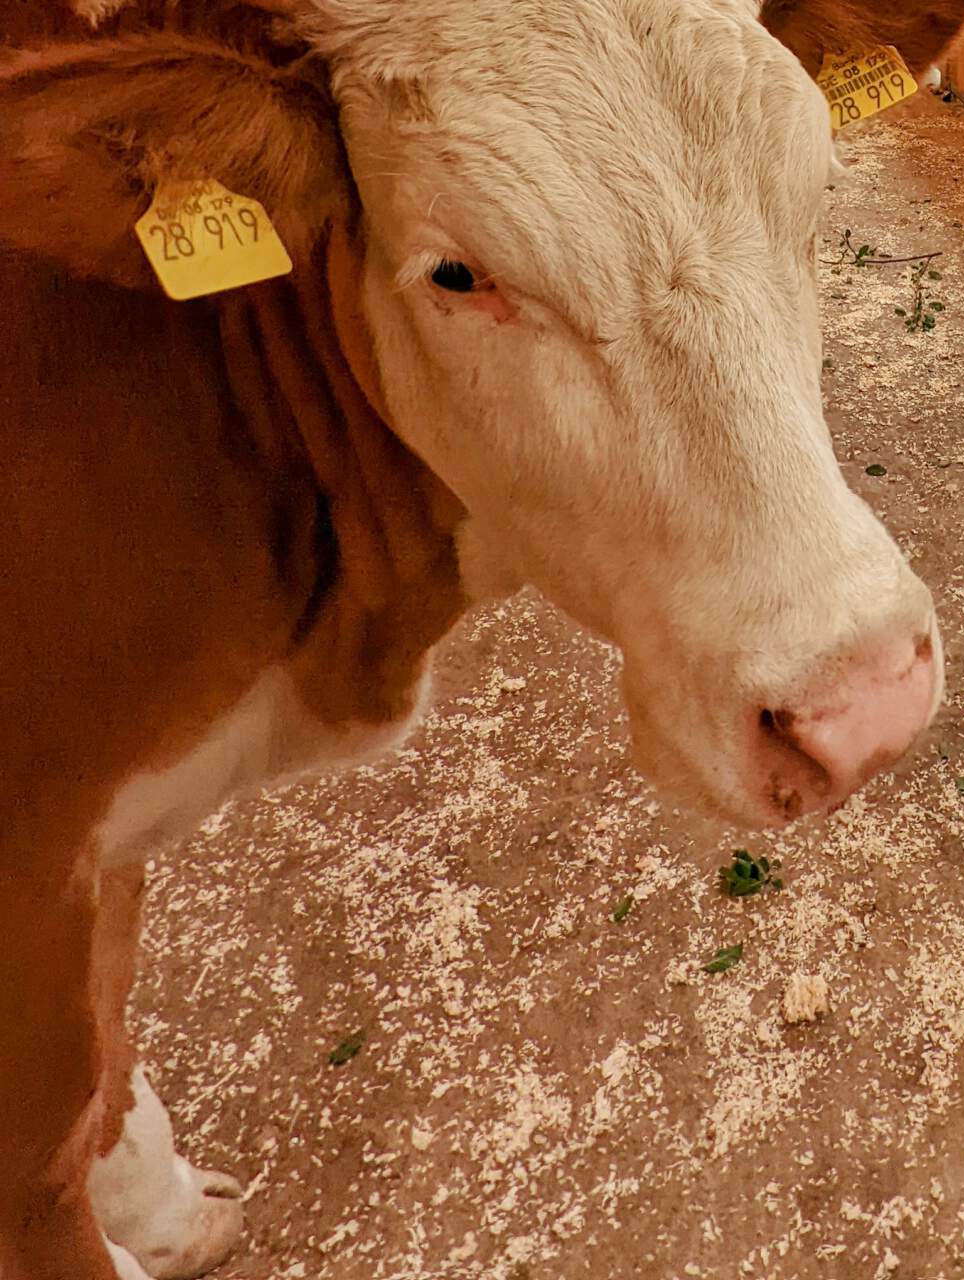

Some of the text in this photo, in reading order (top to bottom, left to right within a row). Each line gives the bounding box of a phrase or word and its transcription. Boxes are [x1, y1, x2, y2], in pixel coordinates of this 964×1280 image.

[843, 65, 860, 79] 08
[831, 73, 904, 127] 28 919
[149, 208, 259, 261] 28 919
